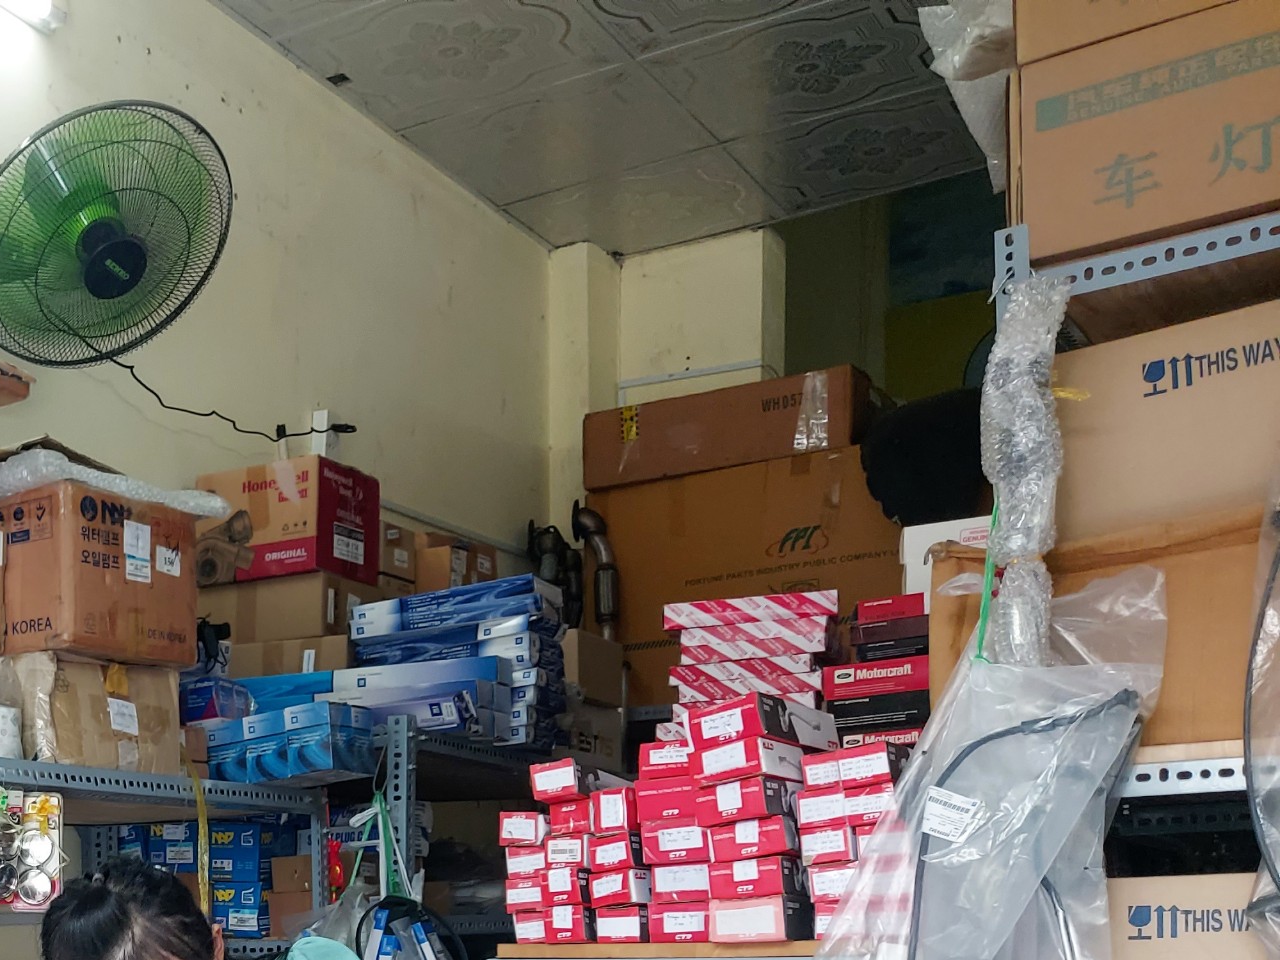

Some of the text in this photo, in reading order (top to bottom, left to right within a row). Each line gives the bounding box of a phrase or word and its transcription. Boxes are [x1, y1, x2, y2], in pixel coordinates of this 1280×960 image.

[1194, 347, 1239, 379] THIS
[80, 550, 120, 569] 오일펌프
[264, 548, 308, 562] ORIGINAL
[685, 550, 888, 587] FORTUNE PARTS INDUSTRY PUBLIC COMPANY
[12, 616, 53, 636] KOREA
[856, 663, 912, 680] Motorcraft
[1181, 909, 1223, 933] THIS
